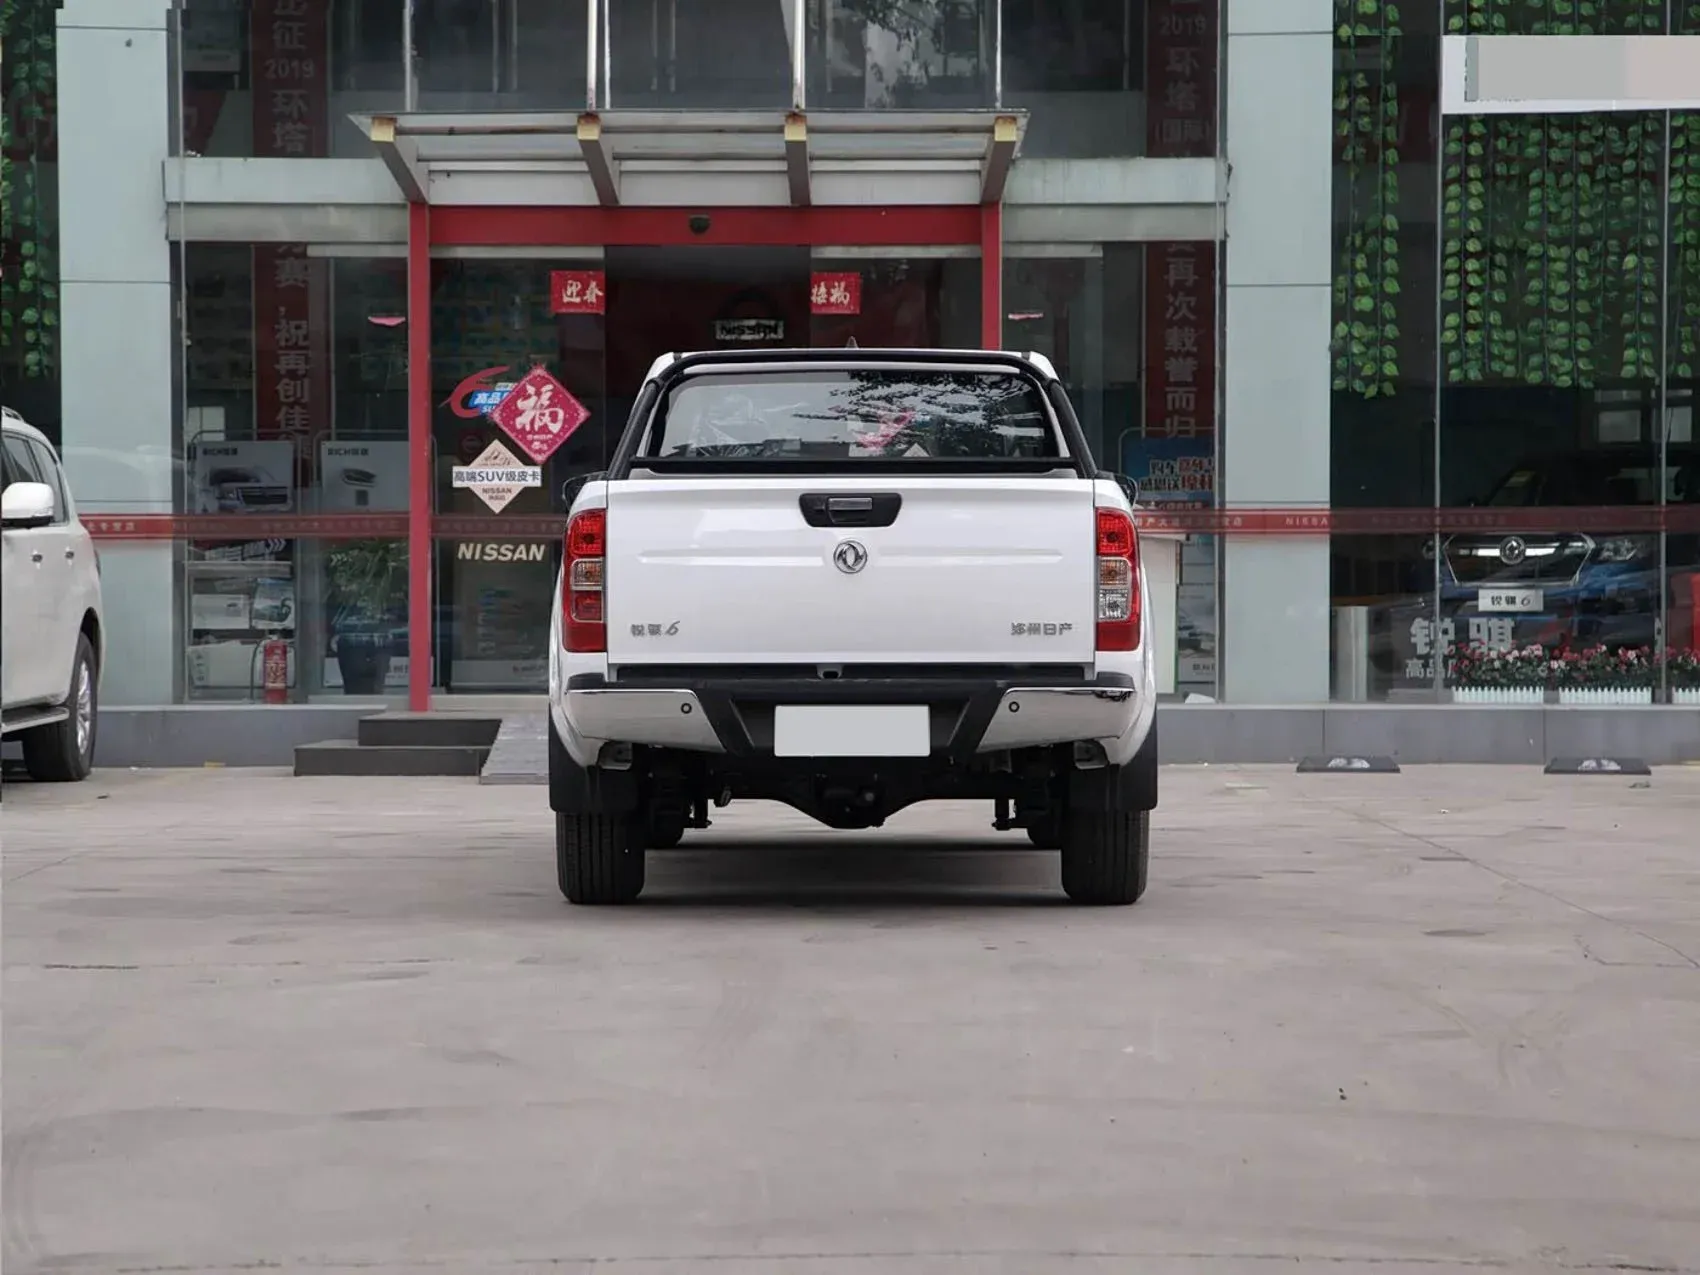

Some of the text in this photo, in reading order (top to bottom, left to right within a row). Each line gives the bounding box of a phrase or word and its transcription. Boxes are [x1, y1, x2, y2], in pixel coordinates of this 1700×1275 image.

[561, 279, 605, 305] 迎春
[515, 383, 565, 434] 福
[453, 470, 541, 484] 高端SUV级皮卡
[457, 543, 546, 561] NISSAN
